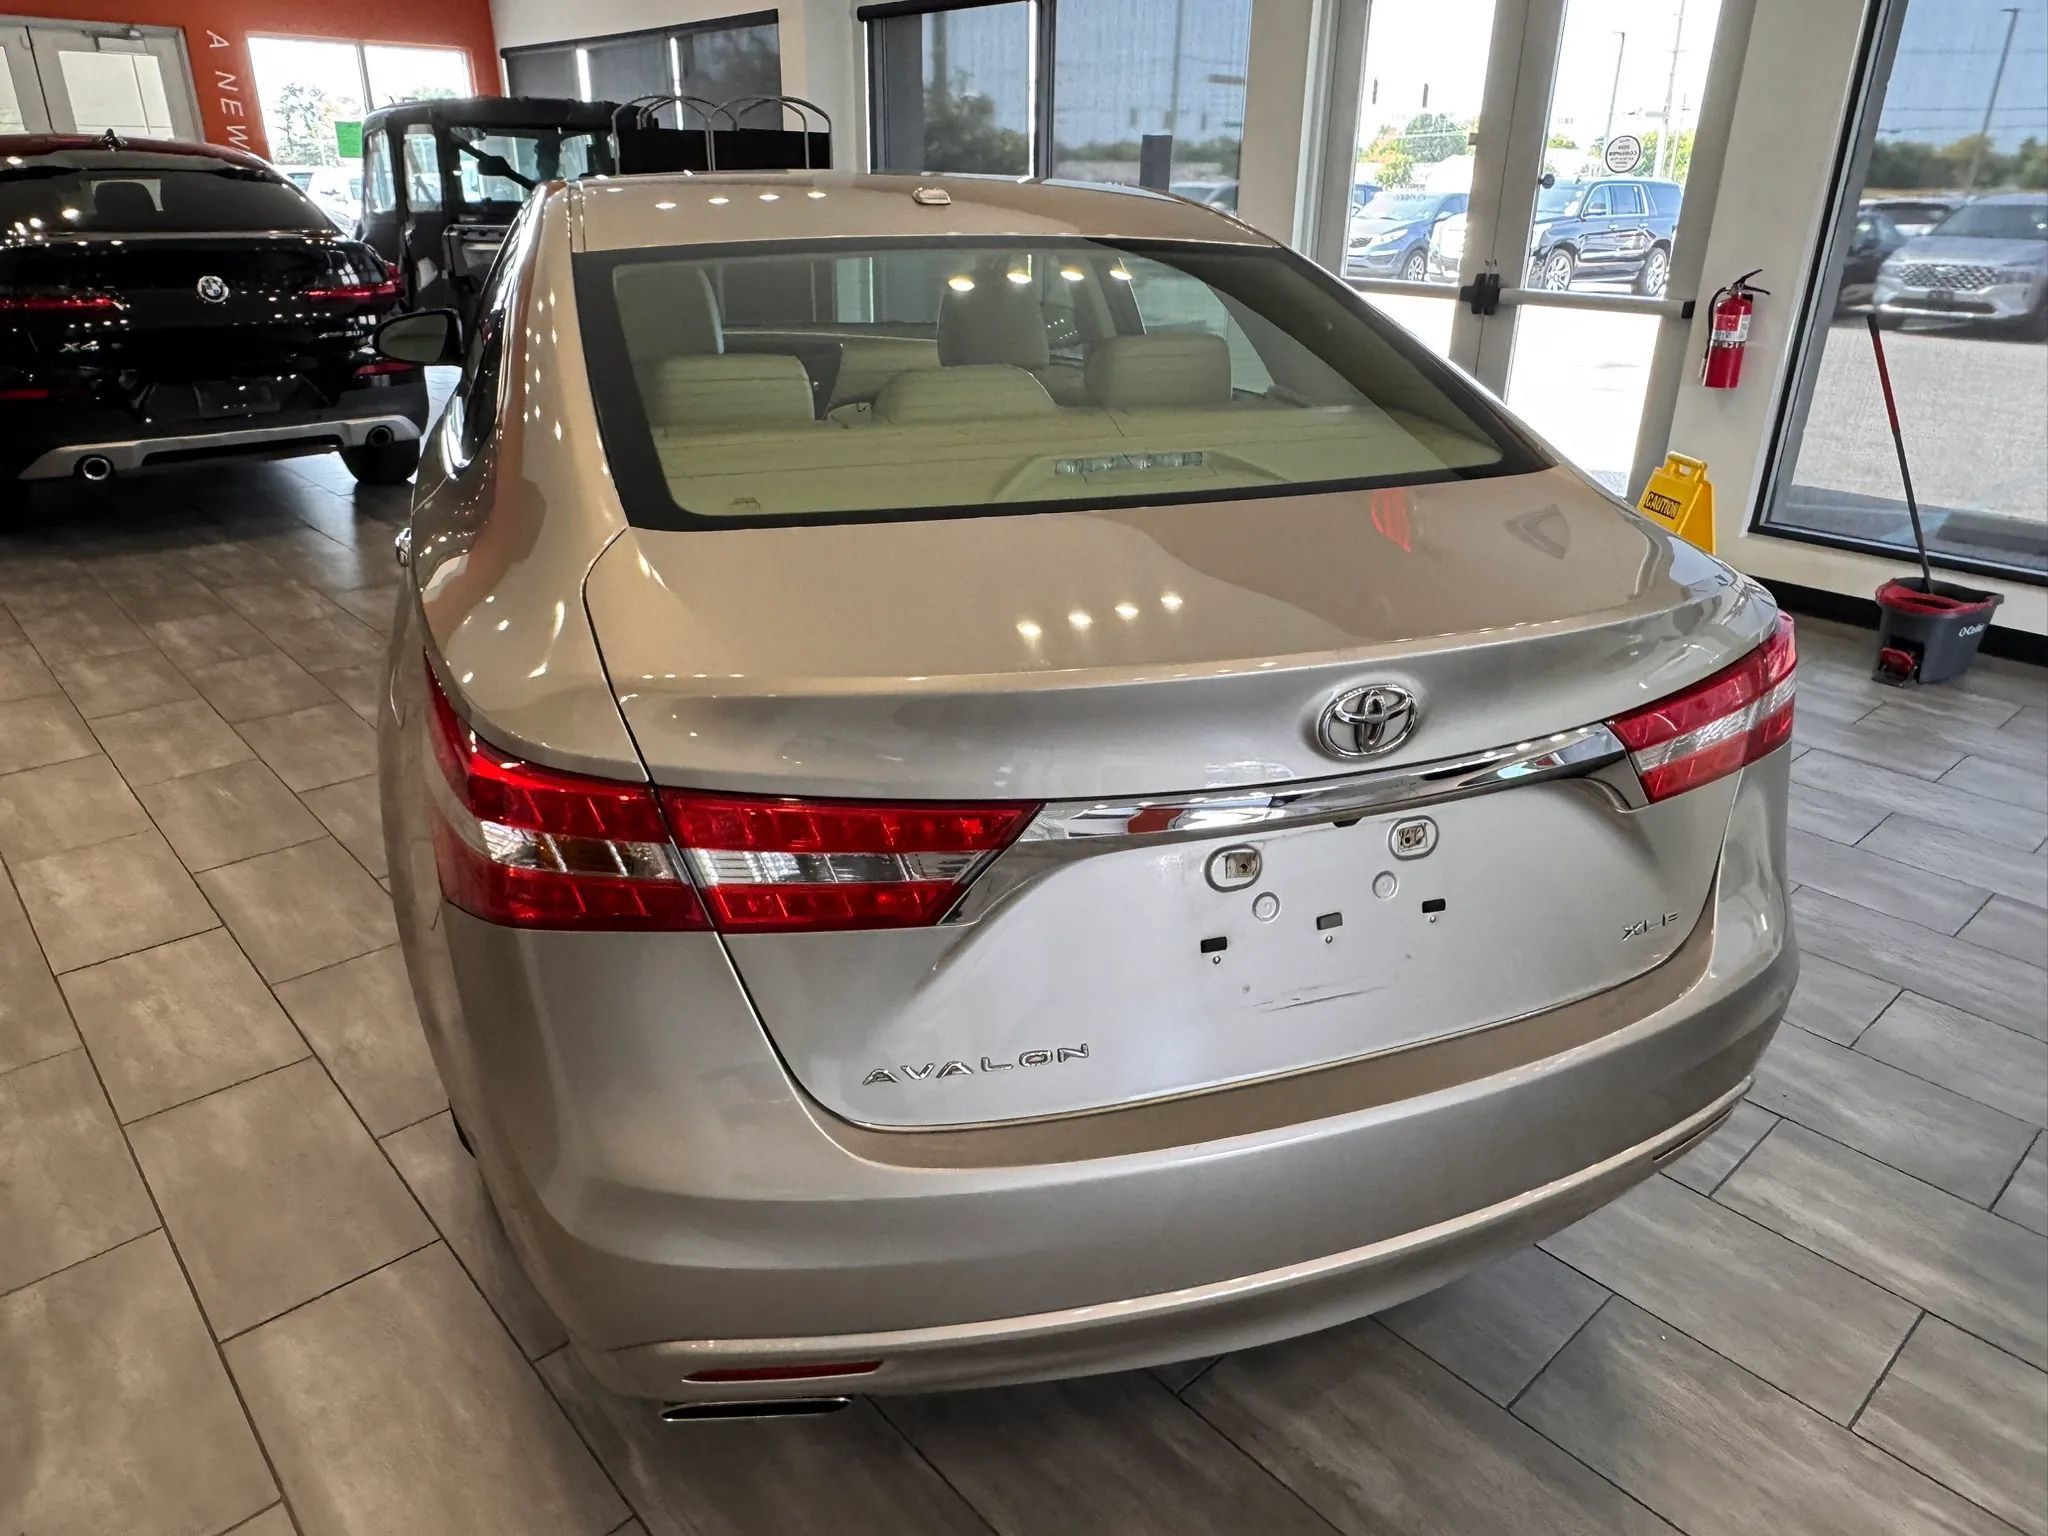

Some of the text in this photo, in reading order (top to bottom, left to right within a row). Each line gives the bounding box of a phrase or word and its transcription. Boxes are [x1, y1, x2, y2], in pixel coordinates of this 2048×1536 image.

[206, 29, 251, 150] A NEW
[1644, 492, 1680, 519] CAUTION
[862, 1043, 1089, 1086] AVALON
